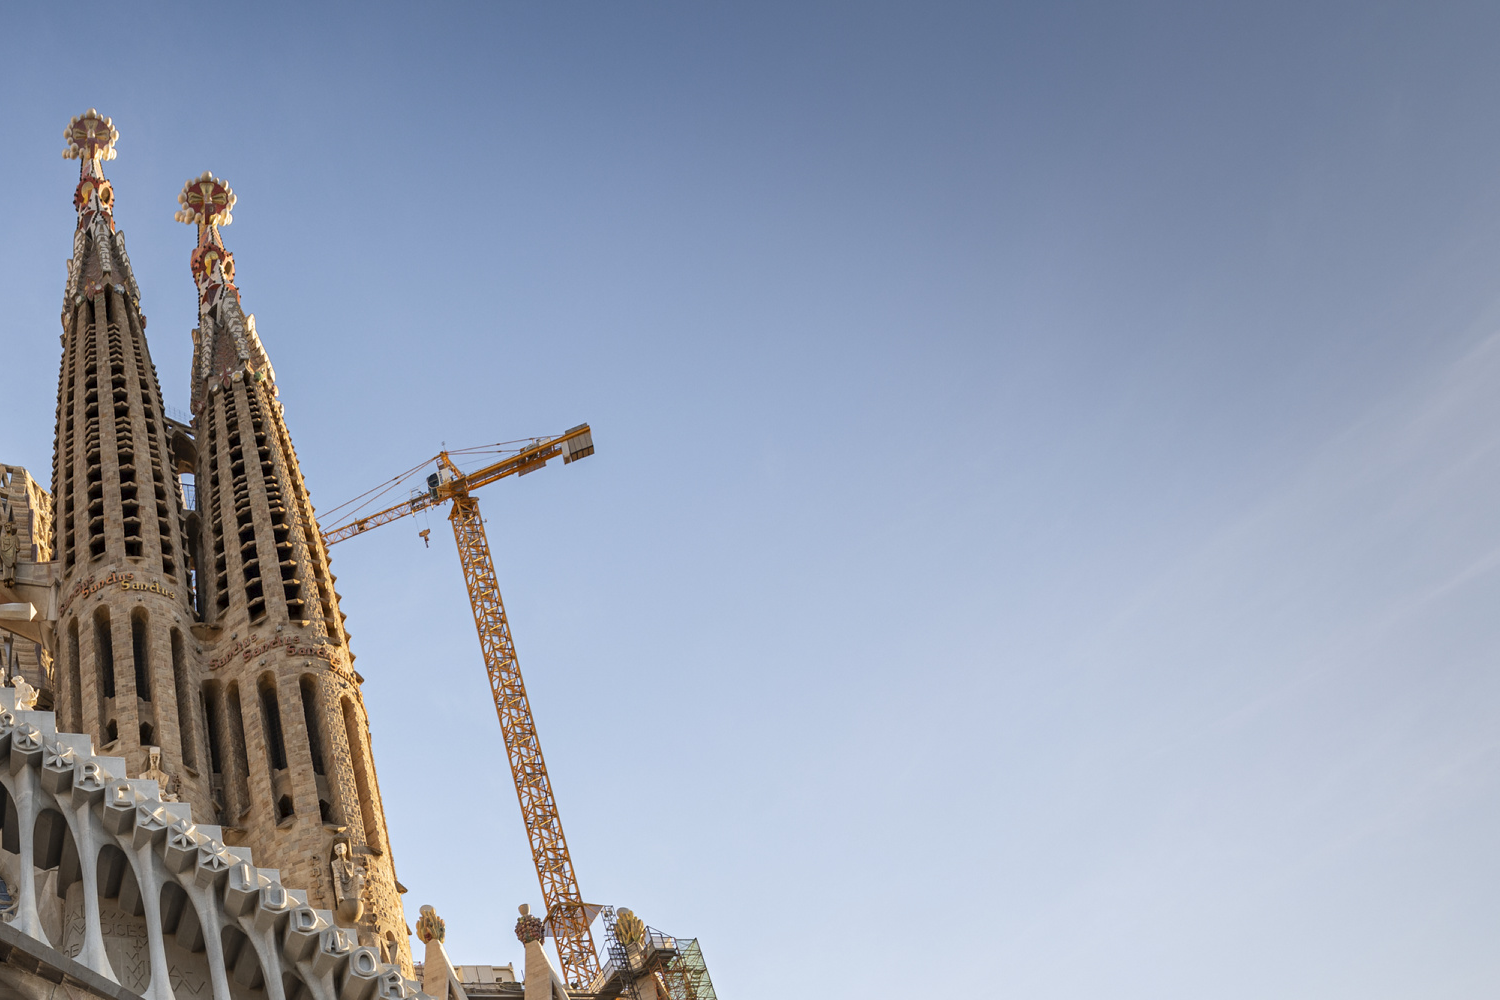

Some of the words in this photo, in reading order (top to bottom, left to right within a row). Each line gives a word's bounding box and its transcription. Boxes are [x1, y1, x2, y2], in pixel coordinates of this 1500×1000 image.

[81, 572, 134, 599] Sanctus
[121, 579, 175, 600] Sanctus
[243, 635, 300, 663] Sanctus
[79, 762, 167, 826] REX
